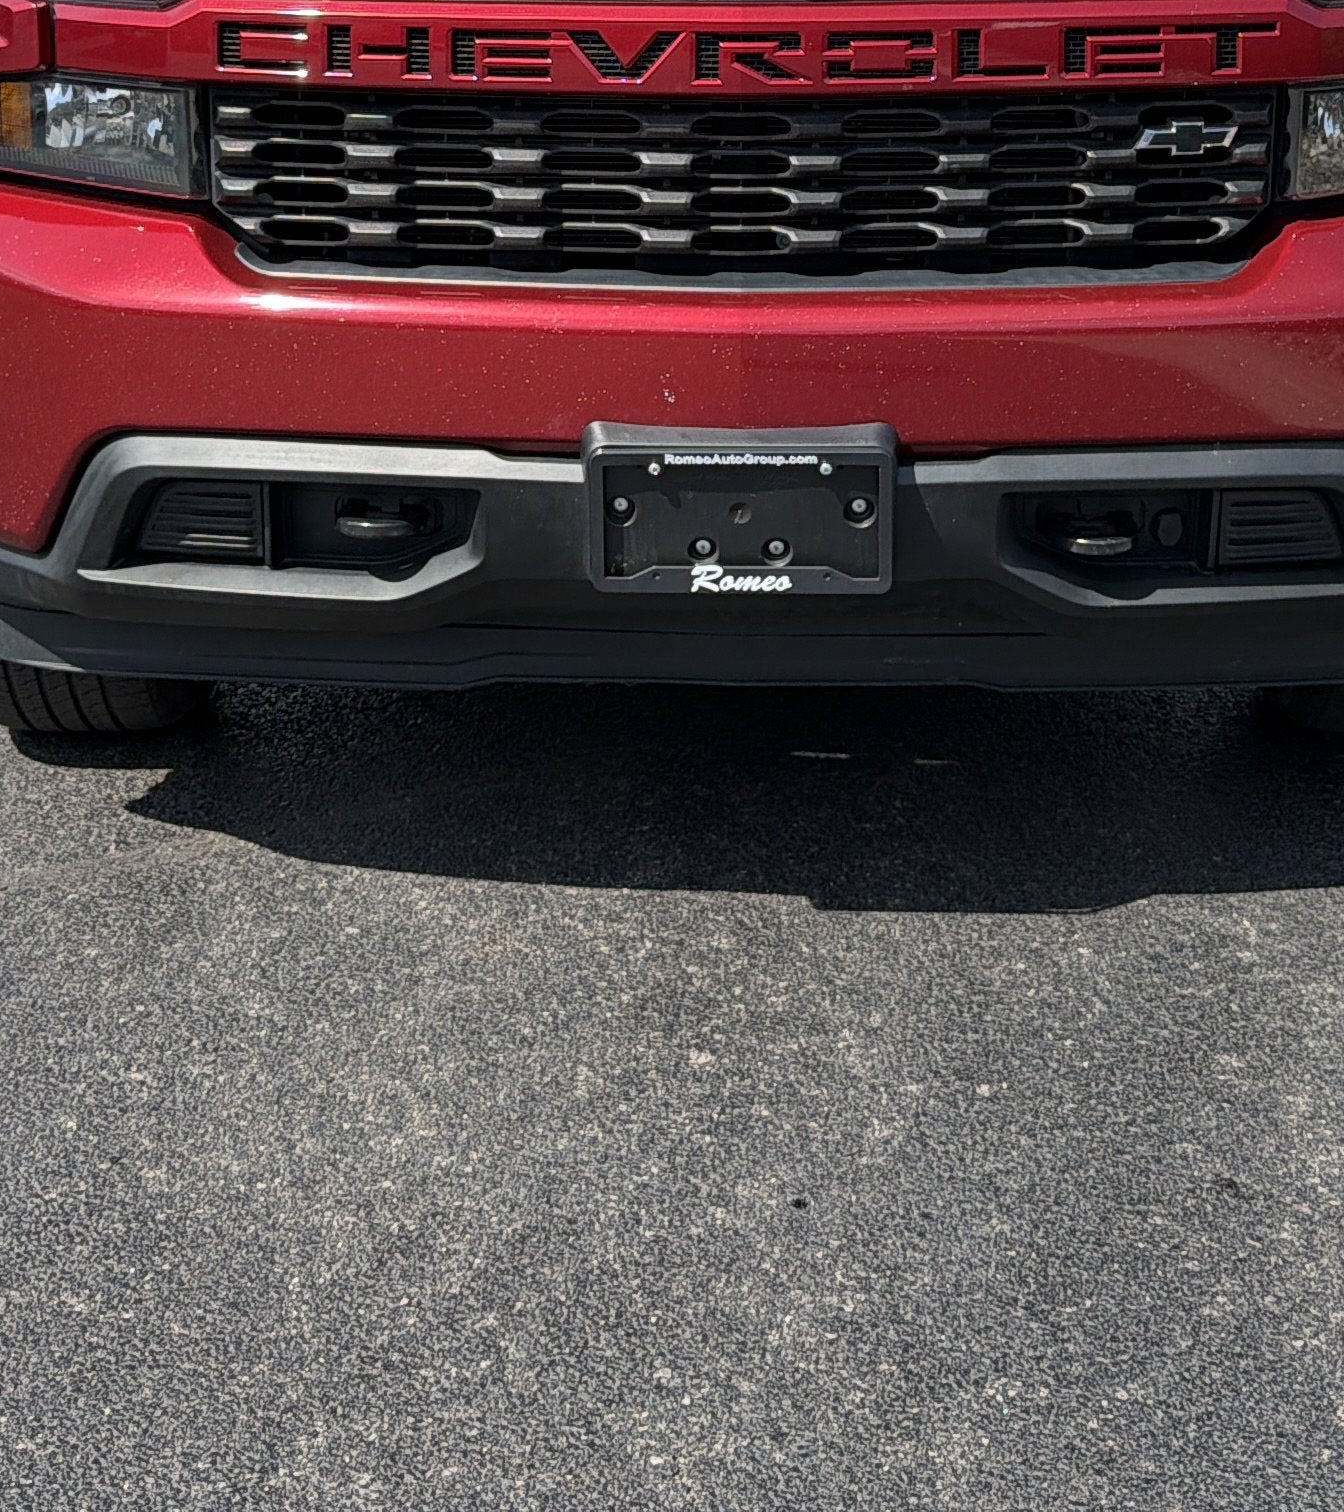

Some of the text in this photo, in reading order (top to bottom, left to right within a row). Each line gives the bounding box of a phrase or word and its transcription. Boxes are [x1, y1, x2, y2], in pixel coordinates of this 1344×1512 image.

[216, 20, 1281, 85] CHEVROLET
[664, 453, 818, 467] RomeoAutoGroup.com
[690, 564, 792, 593] Romeo
